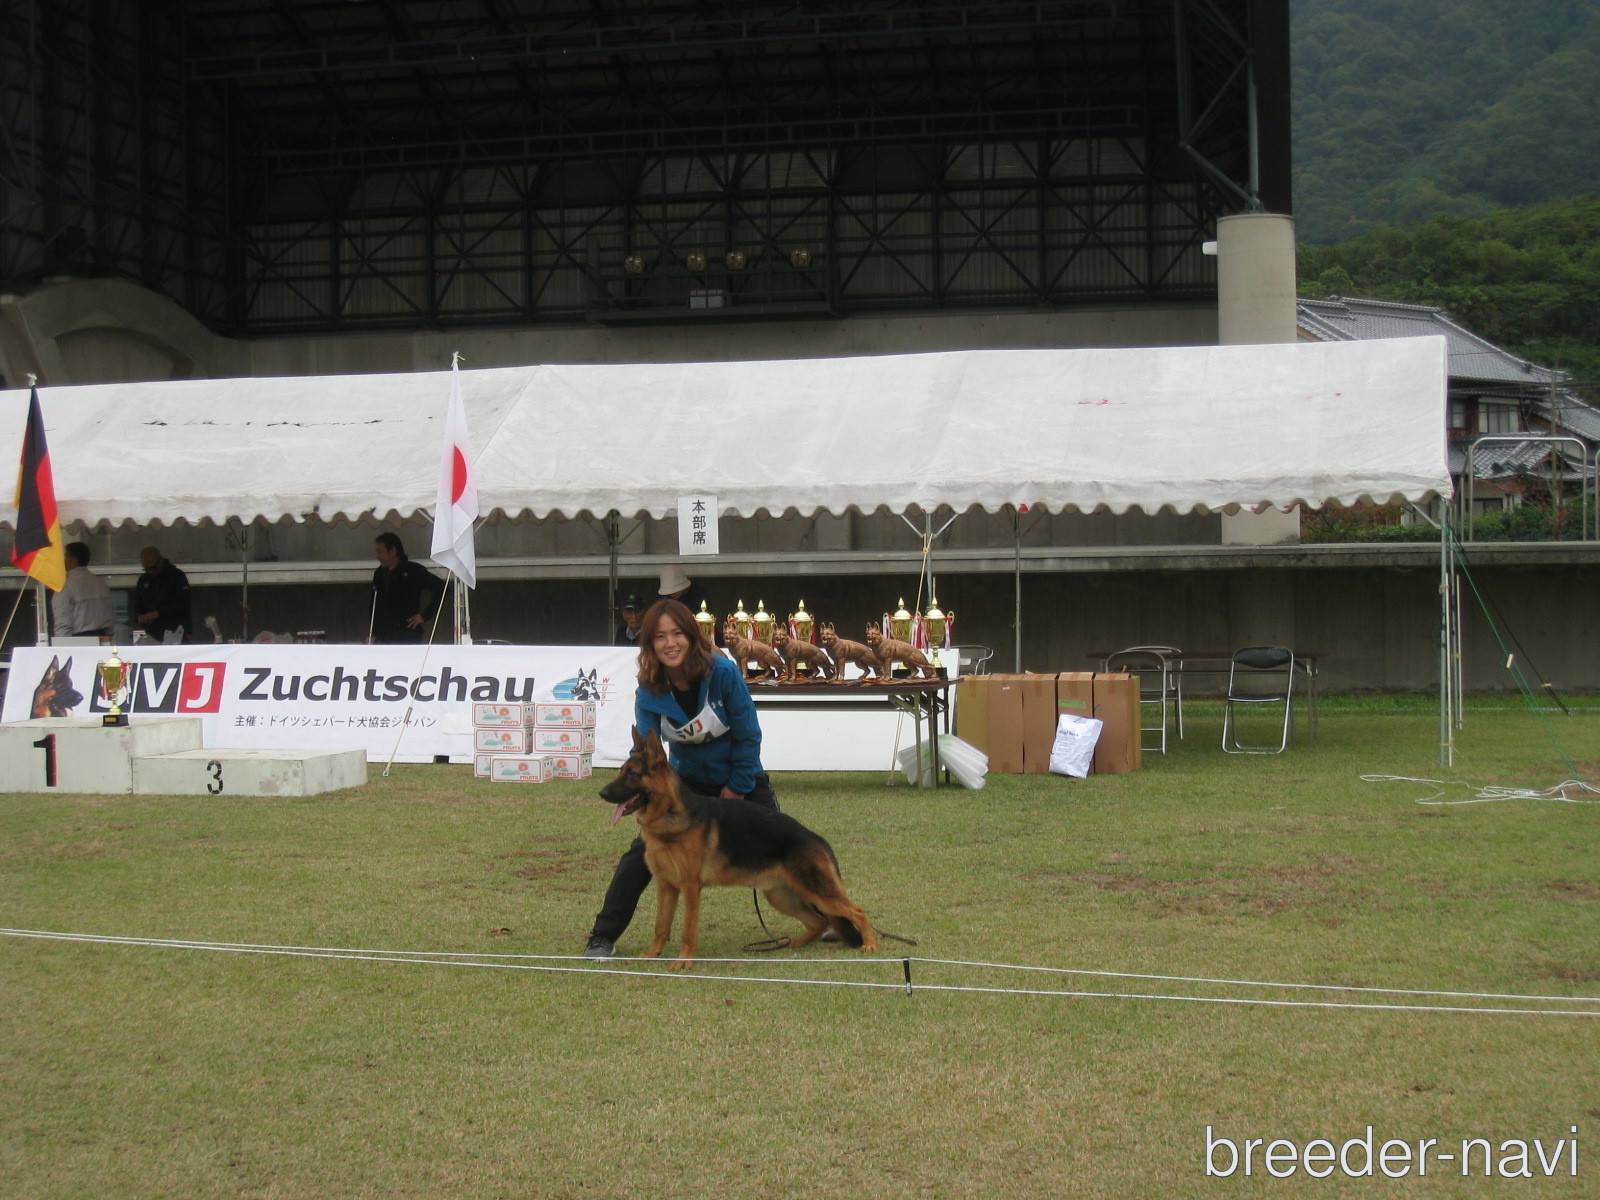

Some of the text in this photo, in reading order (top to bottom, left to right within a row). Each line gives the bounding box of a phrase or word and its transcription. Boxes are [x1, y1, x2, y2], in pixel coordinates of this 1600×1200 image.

[691, 499, 707, 546] 本部席
[238, 666, 535, 702] Zuchtschau
[33, 733, 57, 787] 1
[206, 760, 224, 795] 3
